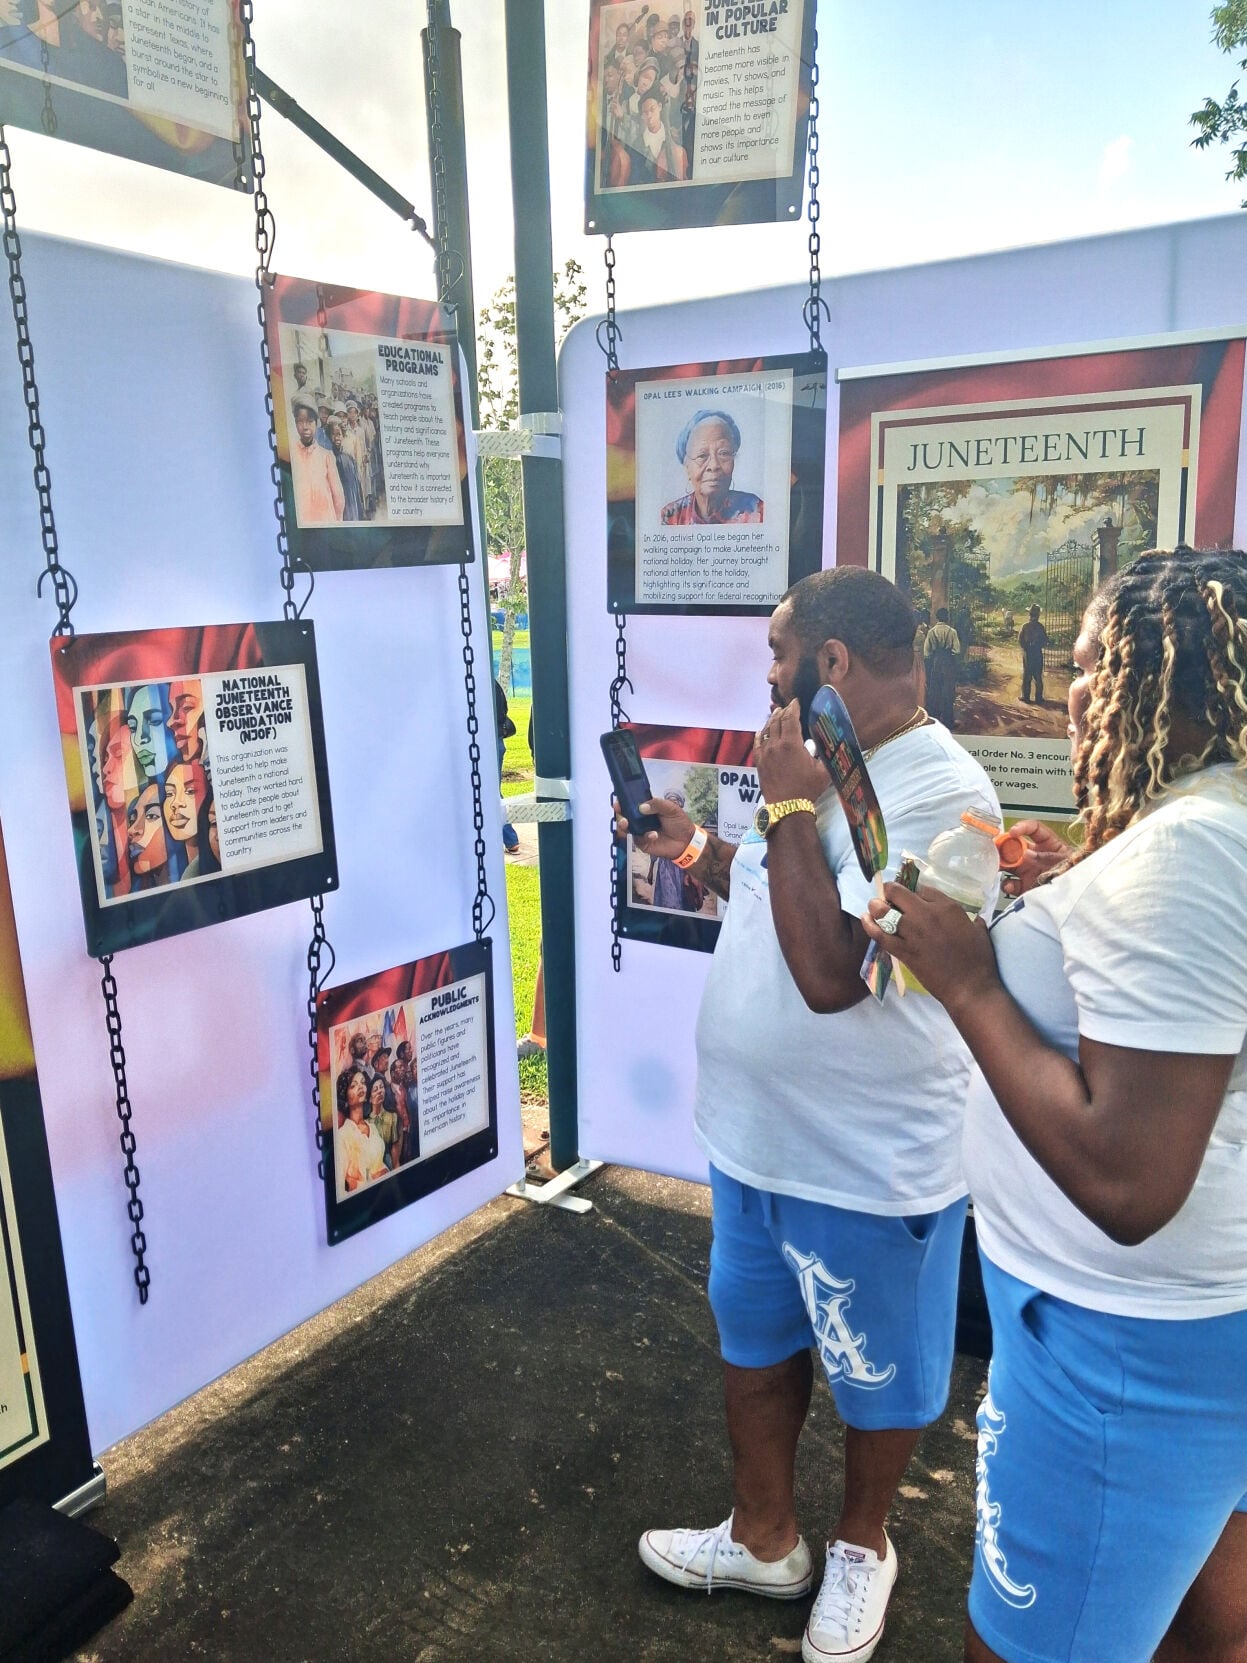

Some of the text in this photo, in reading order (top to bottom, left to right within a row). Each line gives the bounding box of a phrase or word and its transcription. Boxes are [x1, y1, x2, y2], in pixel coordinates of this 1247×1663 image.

[706, 10, 719, 26] IN
[725, 0, 788, 23] POPULAR
[715, 16, 777, 40] CULTURE
[704, 45, 760, 60] Juneteenth has
[704, 54, 779, 74] become more visible
[703, 67, 786, 87] movies, TV shows, and
[728, 87, 742, 96] This
[743, 85, 764, 95] helps
[702, 97, 775, 114] spread the message
[701, 111, 770, 126] Juneteenth even
[700, 124, 761, 139] more people and
[700, 137, 779, 152] shows importance
[708, 156, 721, 164] our
[378, 345, 443, 364] EDUCATIONAL
[385, 358, 438, 376] PROGRAMS
[643, 391, 661, 400] OPAL
[684, 387, 719, 396] WALKING
[722, 383, 761, 394] CAMPAIGN
[764, 381, 785, 391] (2016)
[907, 427, 1146, 471] JUNETEENTH
[643, 534, 651, 542] In
[670, 533, 694, 542] activist
[696, 533, 712, 543] Opal
[713, 532, 725, 541] Lee
[727, 532, 750, 542] began
[751, 532, 764, 540] her
[643, 546, 668, 555] walking
[669, 547, 702, 555] campaign
[733, 543, 773, 552] Juneteenth
[643, 557, 669, 565] national
[696, 557, 709, 565] Her
[710, 558, 738, 567] journey
[740, 556, 768, 566] brought
[643, 568, 749, 578] national attention the holiday,
[643, 579, 749, 590] highlighting significance and
[642, 591, 676, 601] mobilizing
[677, 592, 703, 601] support
[705, 591, 715, 600] for
[717, 591, 741, 600] federal
[222, 674, 281, 692] NATIONAL
[215, 686, 291, 706] JUNETEENTH
[215, 698, 293, 719] OBSERVANCE
[219, 711, 292, 732] FOUNDATION
[239, 726, 276, 744] (NJOF)
[216, 754, 230, 763] This
[231, 748, 273, 762] organization
[981, 749, 1009, 759] Order
[1010, 751, 1026, 760] No.
[1027, 751, 1035, 760] 3
[1036, 753, 1071, 762] encour
[216, 757, 287, 775] founded help make
[999, 765, 1009, 773] to
[1010, 766, 1043, 775] remain
[1045, 767, 1067, 777] with
[218, 767, 289, 787] Juneteenth national
[246, 785, 261, 794] They
[262, 779, 287, 790] worked
[288, 776, 303, 785] hard
[720, 771, 759, 788] OPAL
[1005, 780, 1039, 790] wages.
[229, 788, 299, 809] educate people about
[222, 801, 293, 822] Juneteenth and get
[223, 809, 307, 834] support from leaders and
[723, 821, 737, 829] Opal
[224, 831, 267, 846] communities
[268, 826, 290, 836] across
[431, 986, 467, 1010] PUBLIC
[419, 995, 479, 1024] ACKNOWLEDGMENTS
